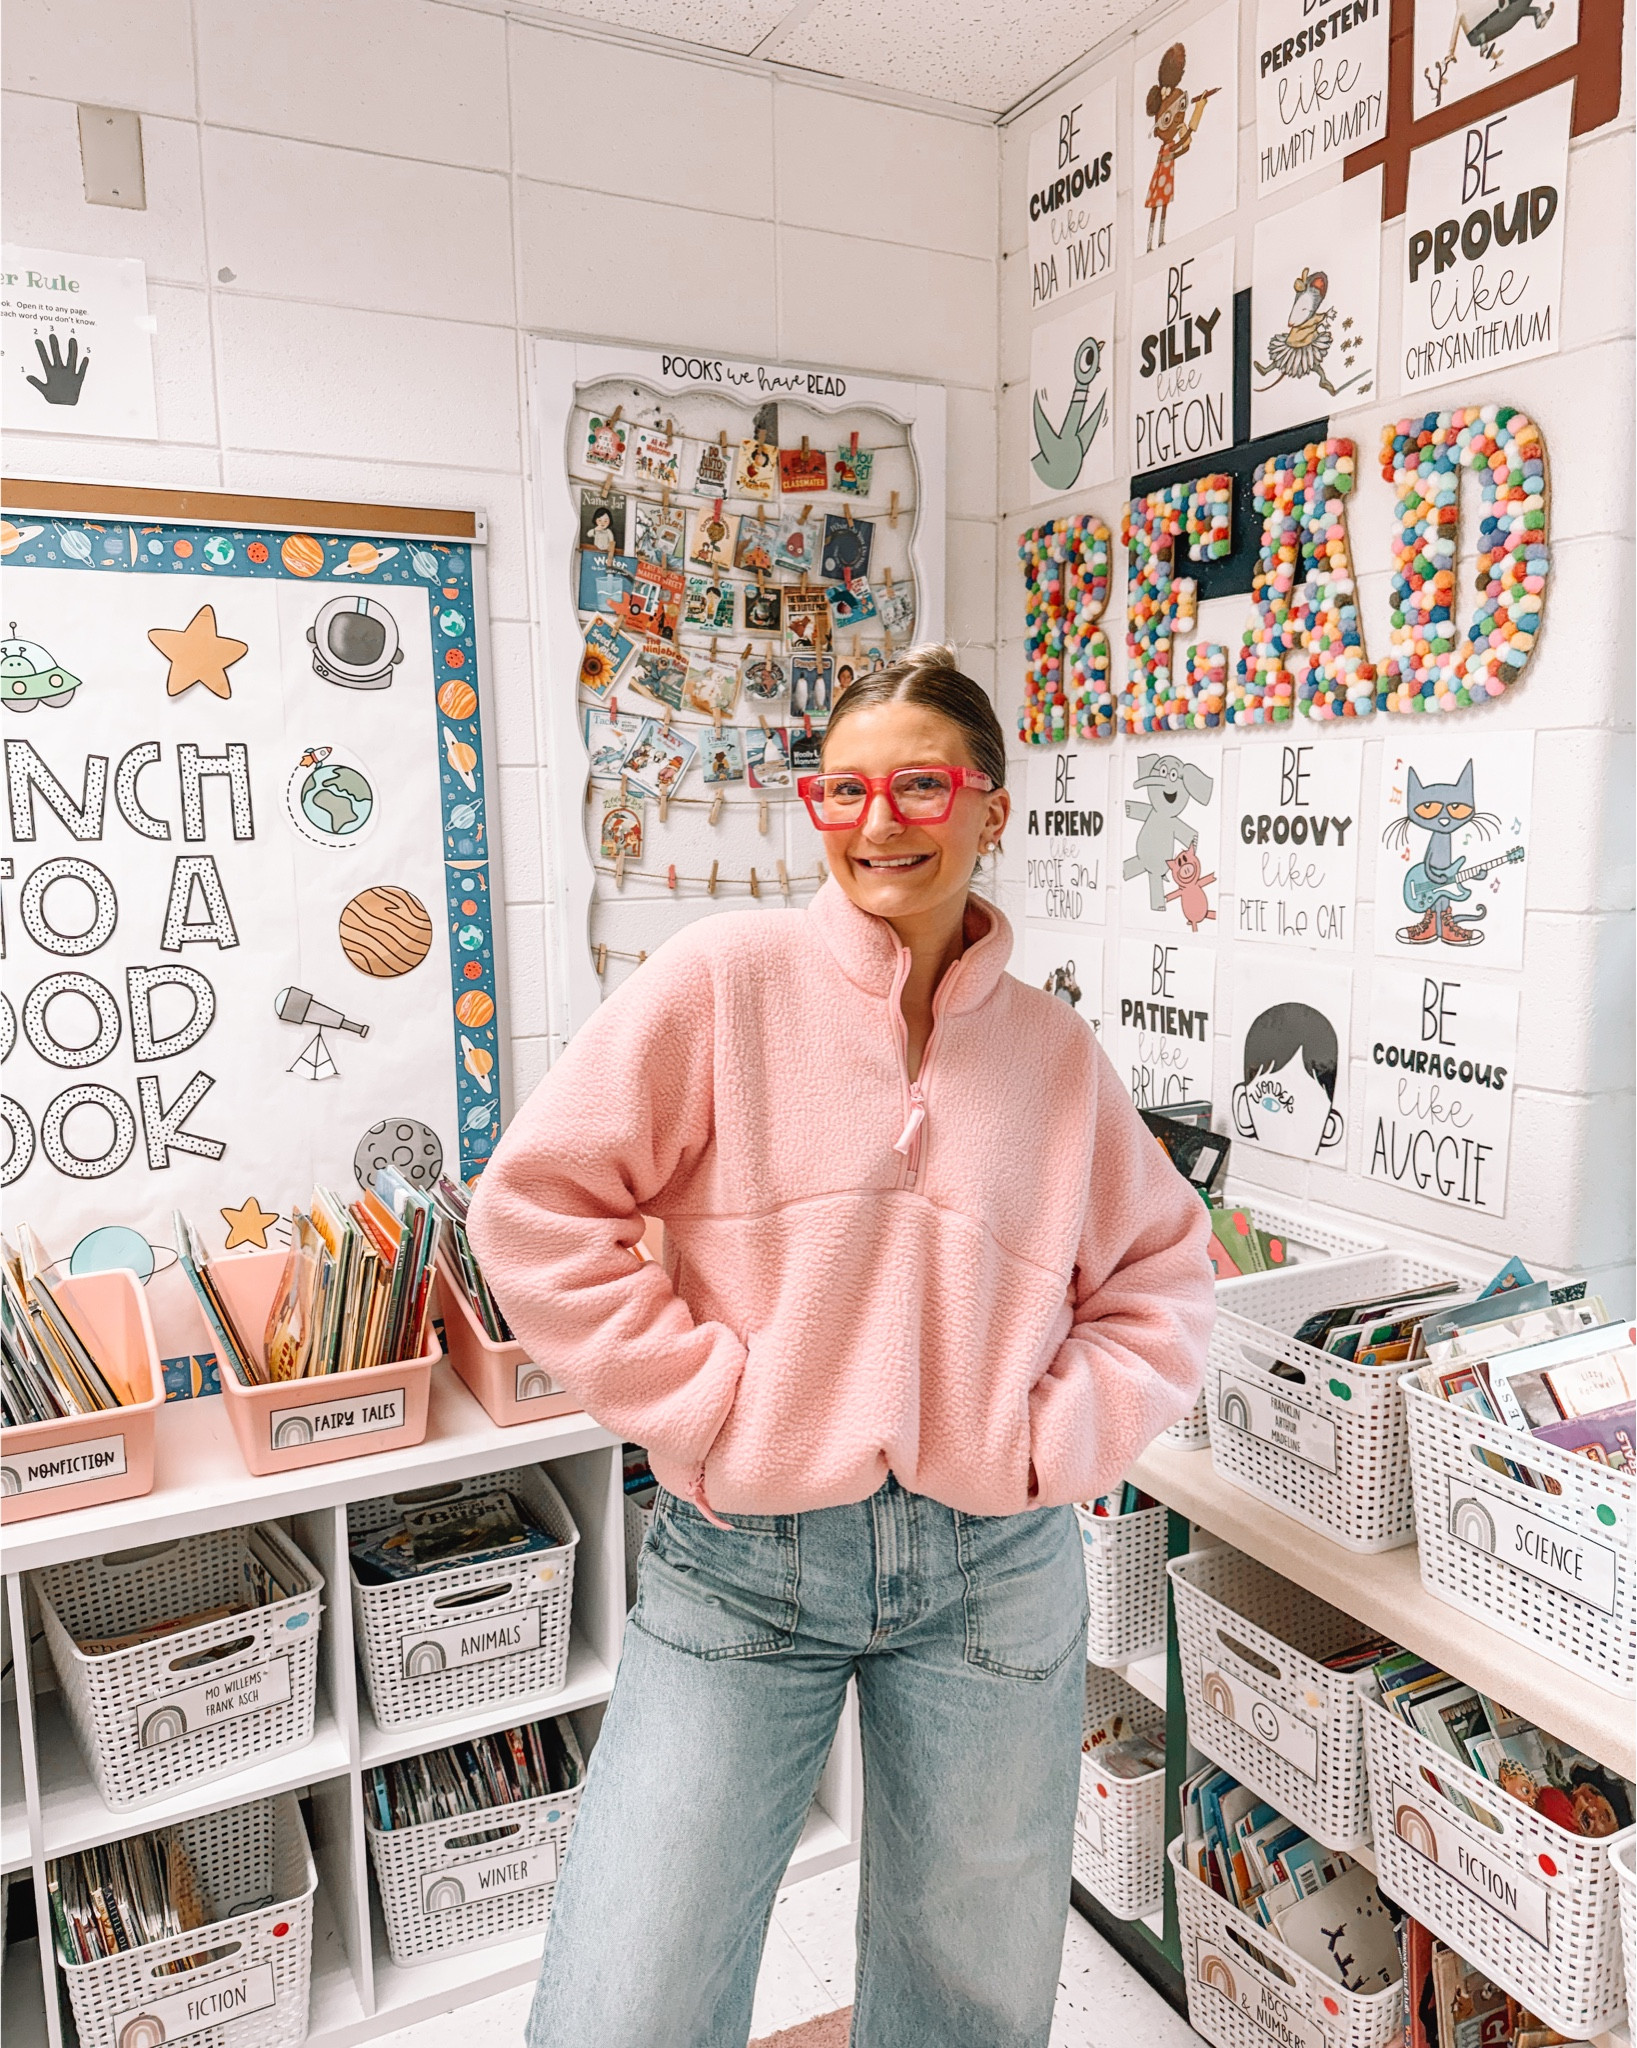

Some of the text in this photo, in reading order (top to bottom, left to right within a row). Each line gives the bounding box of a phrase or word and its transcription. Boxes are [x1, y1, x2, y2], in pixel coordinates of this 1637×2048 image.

[1278, 58, 1361, 125] like
[1058, 104, 1083, 169] BE
[1261, 91, 1383, 183] HUMPTY DUMPTY
[1461, 116, 1508, 205] BE
[1029, 152, 1113, 222] CURIOUS
[1051, 209, 1090, 246] like
[1409, 185, 1559, 283] PROUD
[26, 271, 79, 293] Rule
[1033, 223, 1114, 307] ADA TWIST
[17, 301, 36, 310] Open
[1166, 258, 1195, 325] BE
[1430, 264, 1530, 330] like
[55, 315, 73, 323] don't
[1140, 307, 1221, 377] SILLY
[1406, 305, 1551, 380] CHRYSANTHEMUM
[662, 355, 847, 397] BOOKS we have READ
[1156, 366, 1202, 402] like
[1136, 392, 1223, 469] PIGEON
[582, 491, 625, 509] Name Jar
[783, 478, 825, 489] CLASSMATES
[1018, 404, 1551, 745] READ
[592, 629, 620, 654] Seed to
[646, 637, 661, 645] The
[4, 739, 255, 842] NCH
[1054, 754, 1078, 803] BE
[1280, 746, 1314, 807] BE
[1028, 810, 1104, 837] A FRIEND
[1241, 815, 1352, 847] GROOVY
[1050, 838, 1080, 859] like
[1027, 859, 1099, 890] PIGGIE and
[1261, 851, 1326, 889] like
[160, 855, 240, 952] A
[1046, 888, 1083, 920] GERALD
[1240, 898, 1346, 940] PETE the CAT
[1151, 944, 1178, 998] BE
[0, 964, 216, 1070] OD
[1121, 999, 1209, 1042] PATIENT
[1421, 977, 1461, 1047] BE
[1138, 1031, 1189, 1070] like
[1372, 1042, 1508, 1090] COURAGOUS
[1132, 1065, 1194, 1109] BRUCE
[1397, 1077, 1473, 1128] like
[1371, 1116, 1493, 1206] AUGGIE
[314, 1403, 396, 1432] FAIRY TALES
[1271, 1396, 1300, 1420] FRANKLIN
[1275, 1415, 1297, 1435] ARTHUR
[1271, 1429, 1301, 1453] MADELINE
[28, 1451, 115, 1482] NONFICTION
[1515, 1524, 1583, 1581] SCIENCE
[461, 1625, 521, 1657] ANIMALS
[205, 1671, 262, 1700] MO WILLEMS
[205, 1689, 259, 1717] FRANK ASCH
[478, 1860, 528, 1889] WINTER
[1458, 1847, 1517, 1912] FICTION
[187, 1985, 247, 2021] FICTION
[1241, 1992, 1306, 2048] & NUMBERS
[1261, 1987, 1288, 2022] ABCS
